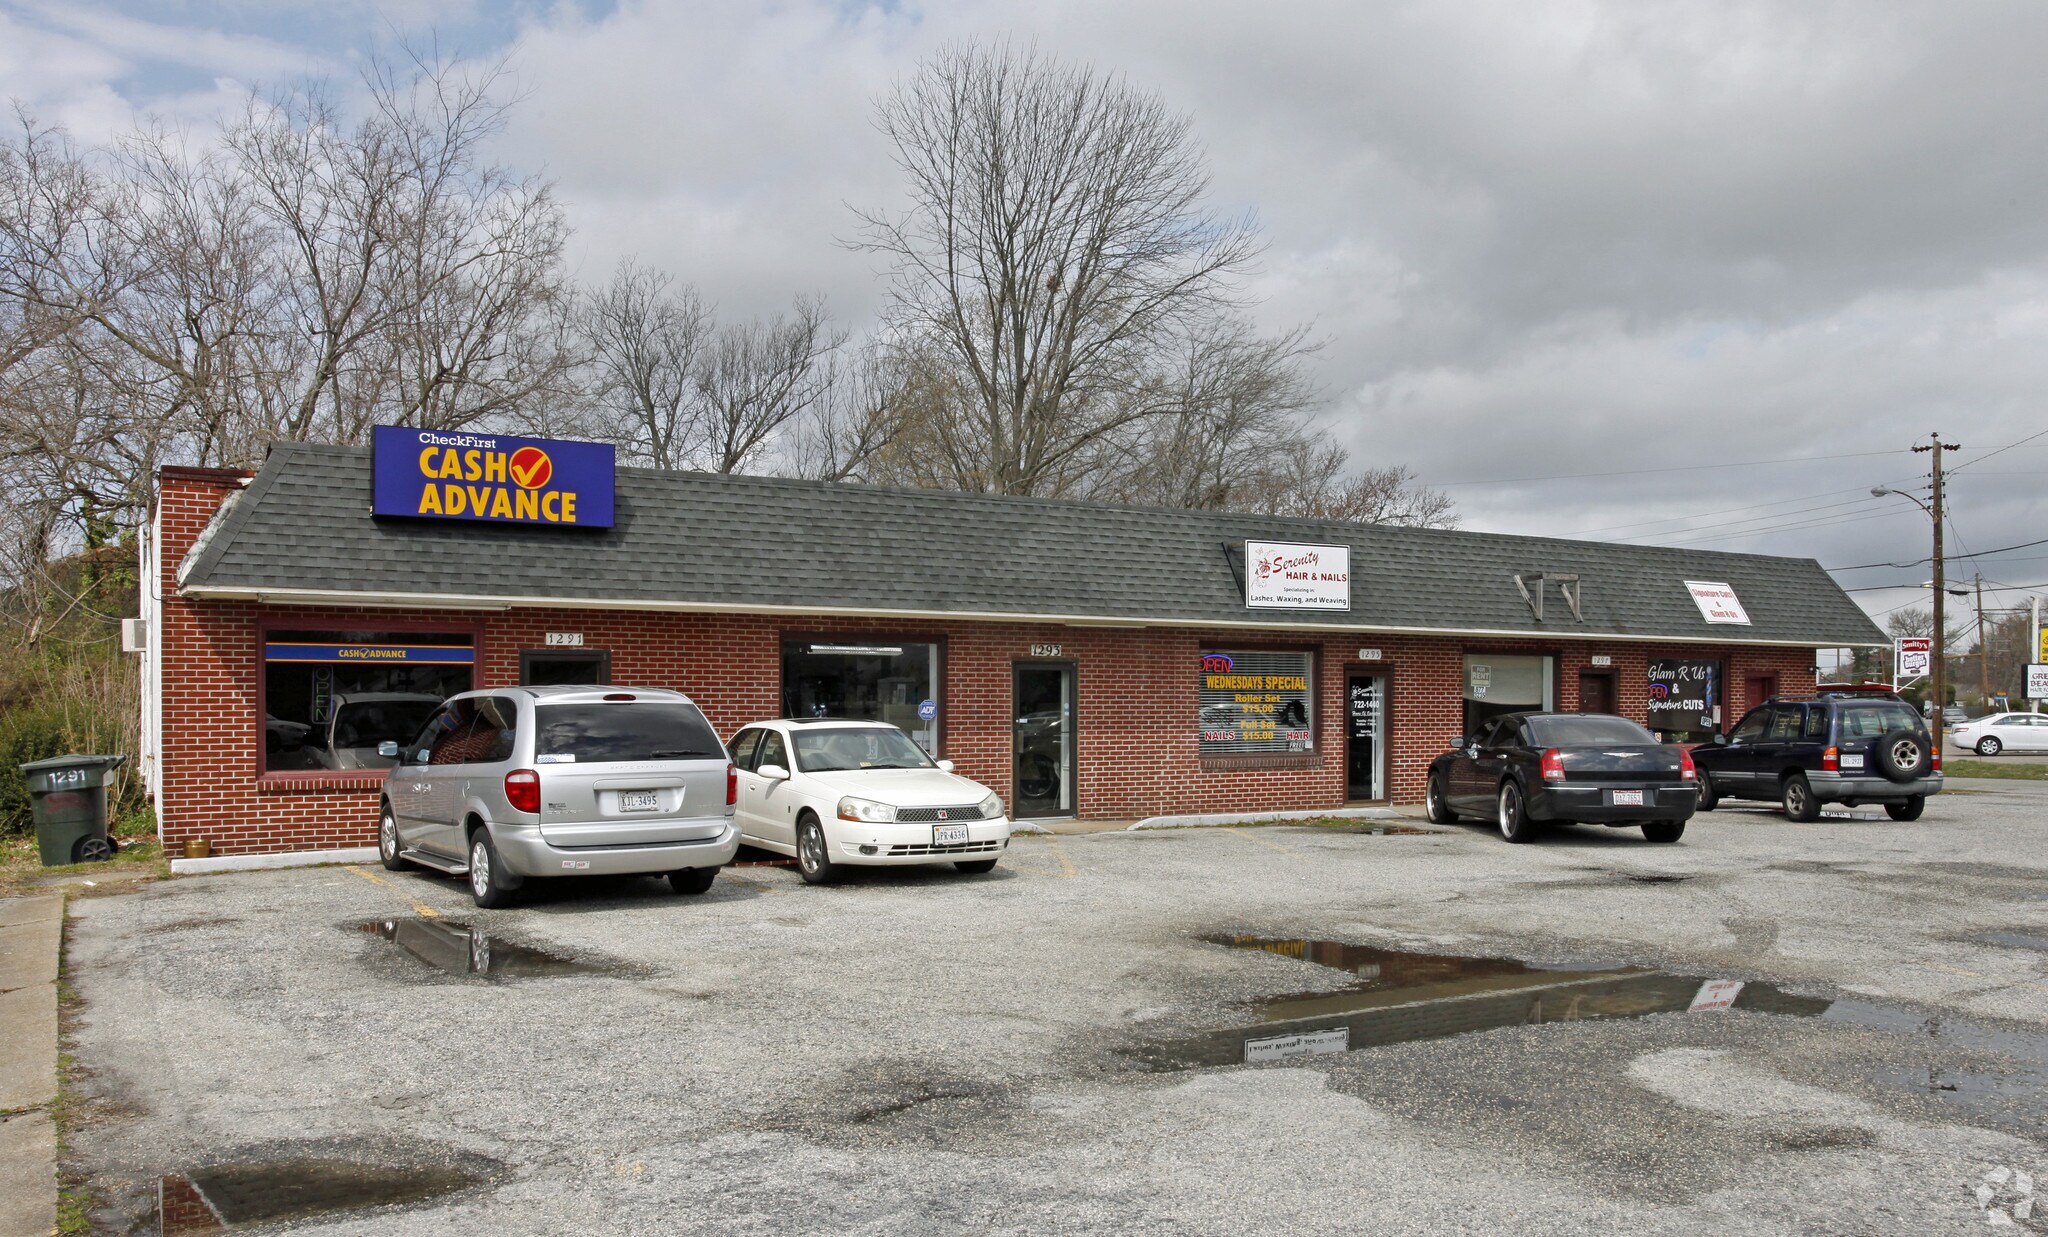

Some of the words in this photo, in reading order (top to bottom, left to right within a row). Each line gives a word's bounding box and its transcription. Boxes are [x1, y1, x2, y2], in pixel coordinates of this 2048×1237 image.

[419, 432, 496, 449] CheckFirst
[419, 446, 507, 483] CASH
[418, 483, 577, 523] ADVANCE
[1273, 551, 1319, 573] Serenity
[1286, 571, 1308, 580] HAIR
[1311, 572, 1318, 581] &
[1320, 573, 1347, 582] NAILS
[1250, 595, 1275, 603] Lashes,
[1276, 595, 1303, 604] Waxing,
[1318, 597, 1347, 606] Weaving
[549, 633, 582, 644] 1291
[338, 649, 360, 658] CASH
[369, 649, 407, 658] ADVANCE
[1033, 645, 1060, 656] 1293
[1361, 650, 1380, 658] 1295
[1200, 657, 1231, 673] OPEN
[1593, 656, 1609, 664] 1297
[1472, 672, 1489, 680] RENT
[1648, 662, 1675, 681] Glam
[1677, 666, 1690, 681] R
[1691, 666, 1706, 680] Us
[1206, 675, 1263, 689] WEDNESDAYS
[1265, 676, 1307, 690] SPECIAL
[315, 667, 330, 721] OPEN
[1647, 686, 1667, 698] OPEN
[1672, 683, 1680, 694] &
[1235, 693, 1263, 703] Roller
[1265, 693, 1281, 703] Set
[920, 706, 936, 715] ADT
[1242, 704, 1275, 713] $15.00
[1647, 698, 1683, 713] Signature
[1683, 699, 1704, 710] CUTS
[1240, 720, 1258, 729] Full
[1260, 720, 1276, 729] Set
[1205, 731, 1235, 741] NAILS
[1242, 731, 1275, 740] $15.00
[1286, 731, 1310, 741] HAIR
[49, 769, 86, 784] 1291
[621, 795, 657, 807] KJL-3495
[936, 830, 966, 840] JPR-4336
